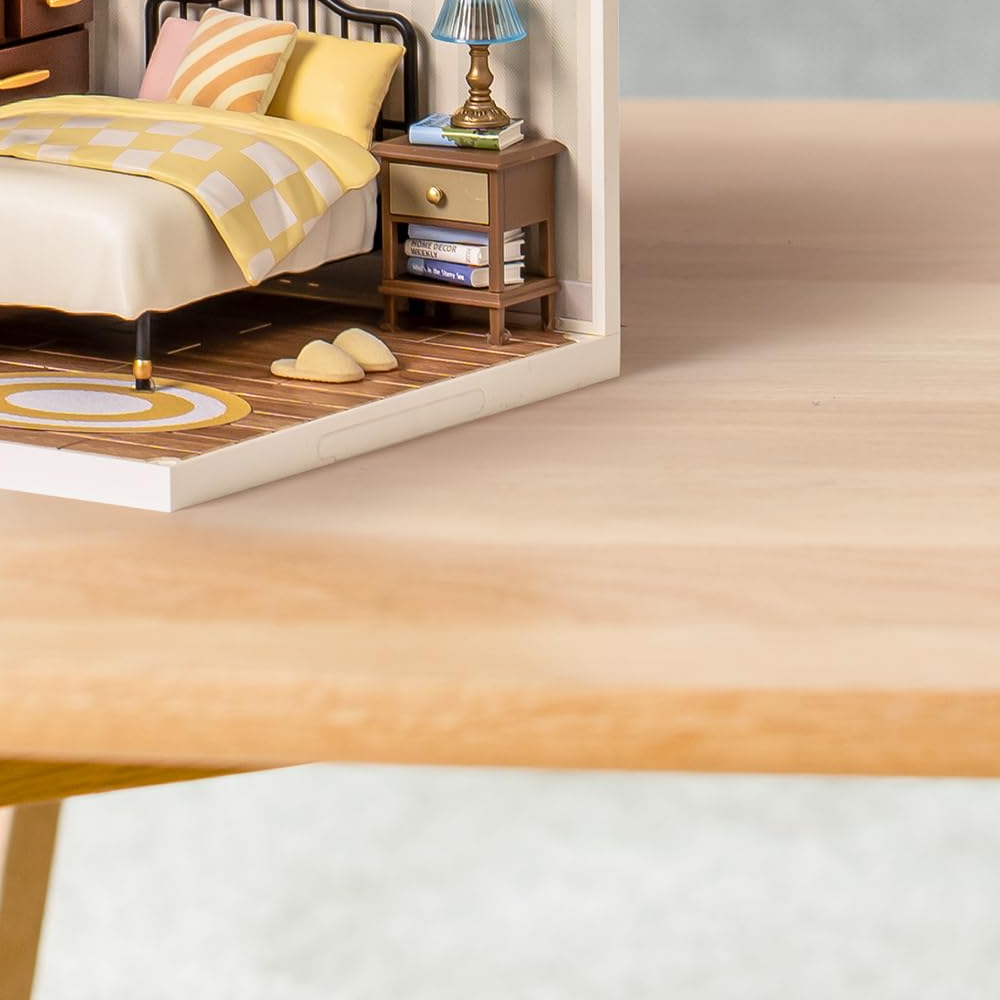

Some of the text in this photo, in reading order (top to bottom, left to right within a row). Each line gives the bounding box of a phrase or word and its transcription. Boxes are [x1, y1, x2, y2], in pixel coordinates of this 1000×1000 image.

[410, 240, 457, 253] HOME DECOR
[410, 248, 438, 259] WEEKLY
